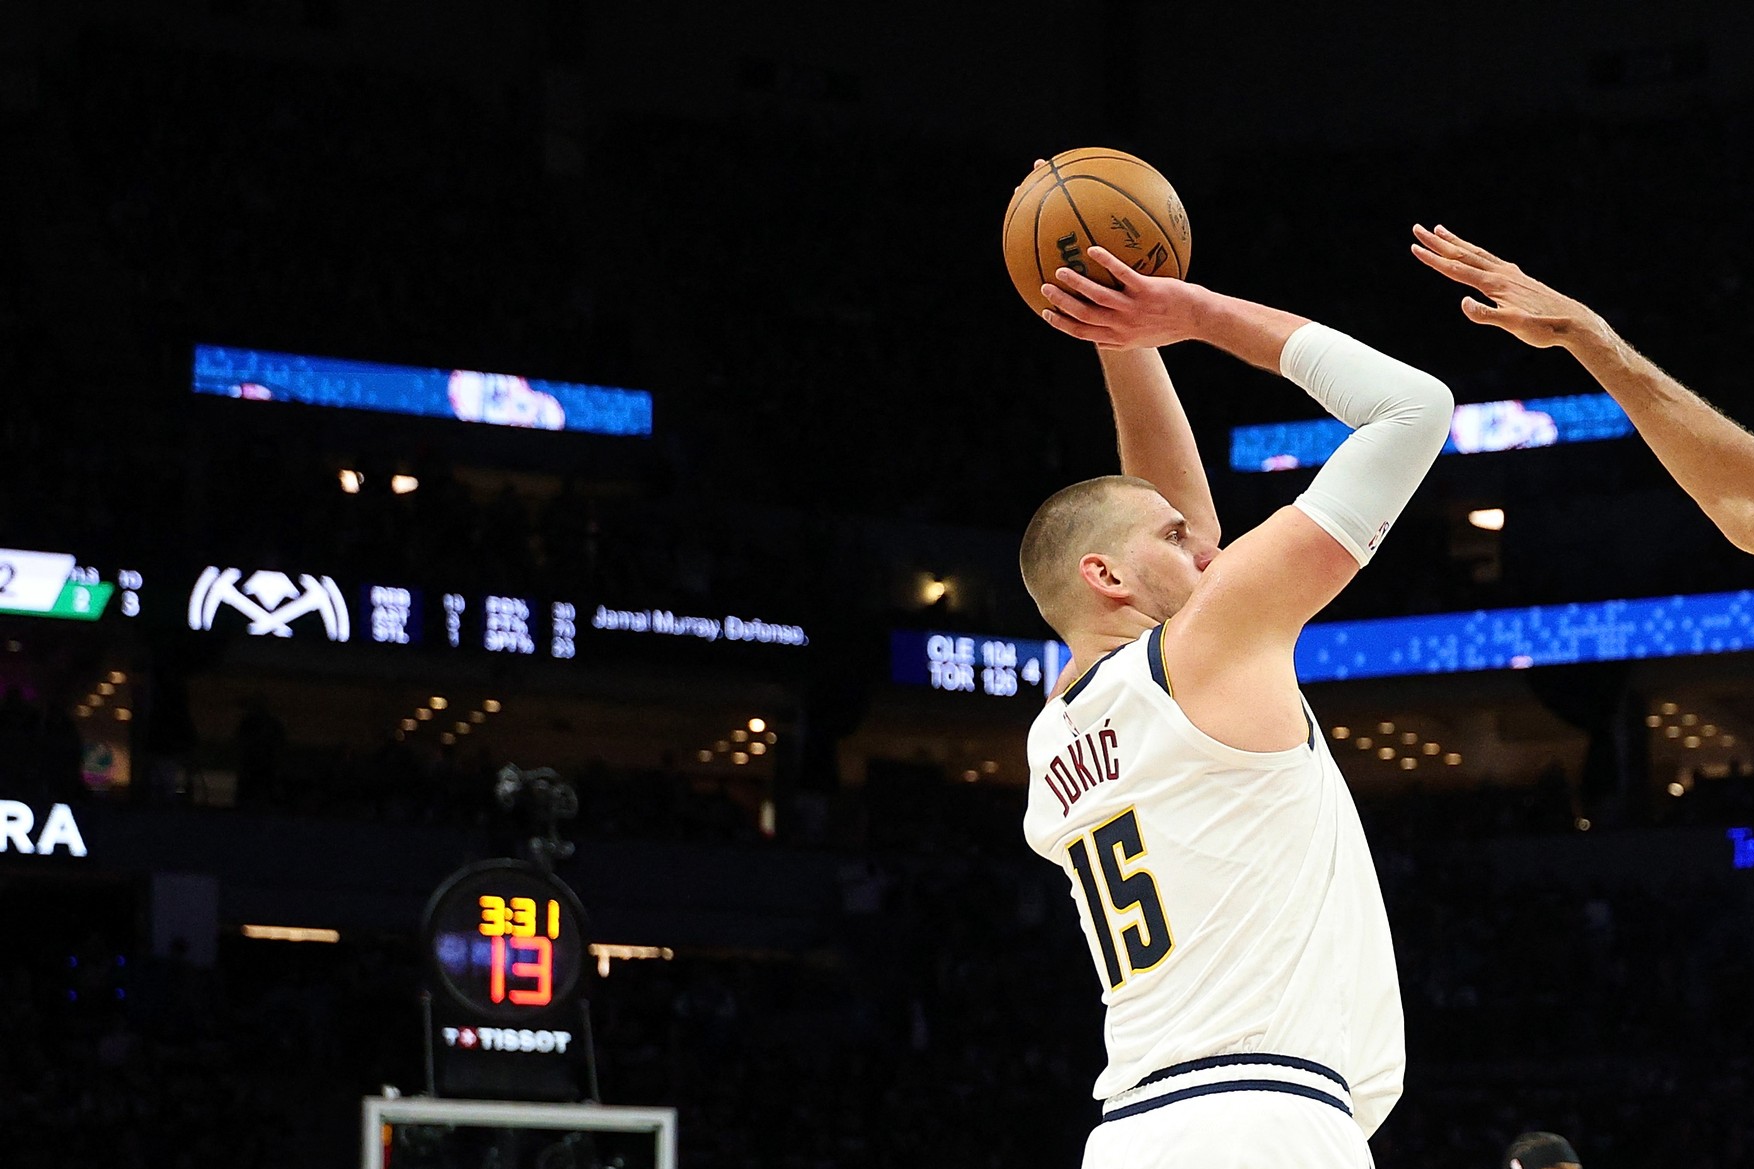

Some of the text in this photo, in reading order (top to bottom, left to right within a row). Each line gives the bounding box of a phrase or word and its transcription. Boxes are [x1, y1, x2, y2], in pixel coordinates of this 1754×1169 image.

[1044, 718, 1120, 818] JOKIĆ
[478, 895, 560, 940] 3:31
[1065, 805, 1177, 992] 15
[490, 936, 554, 1007] 13
[476, 1026, 572, 1055] TISSOT
